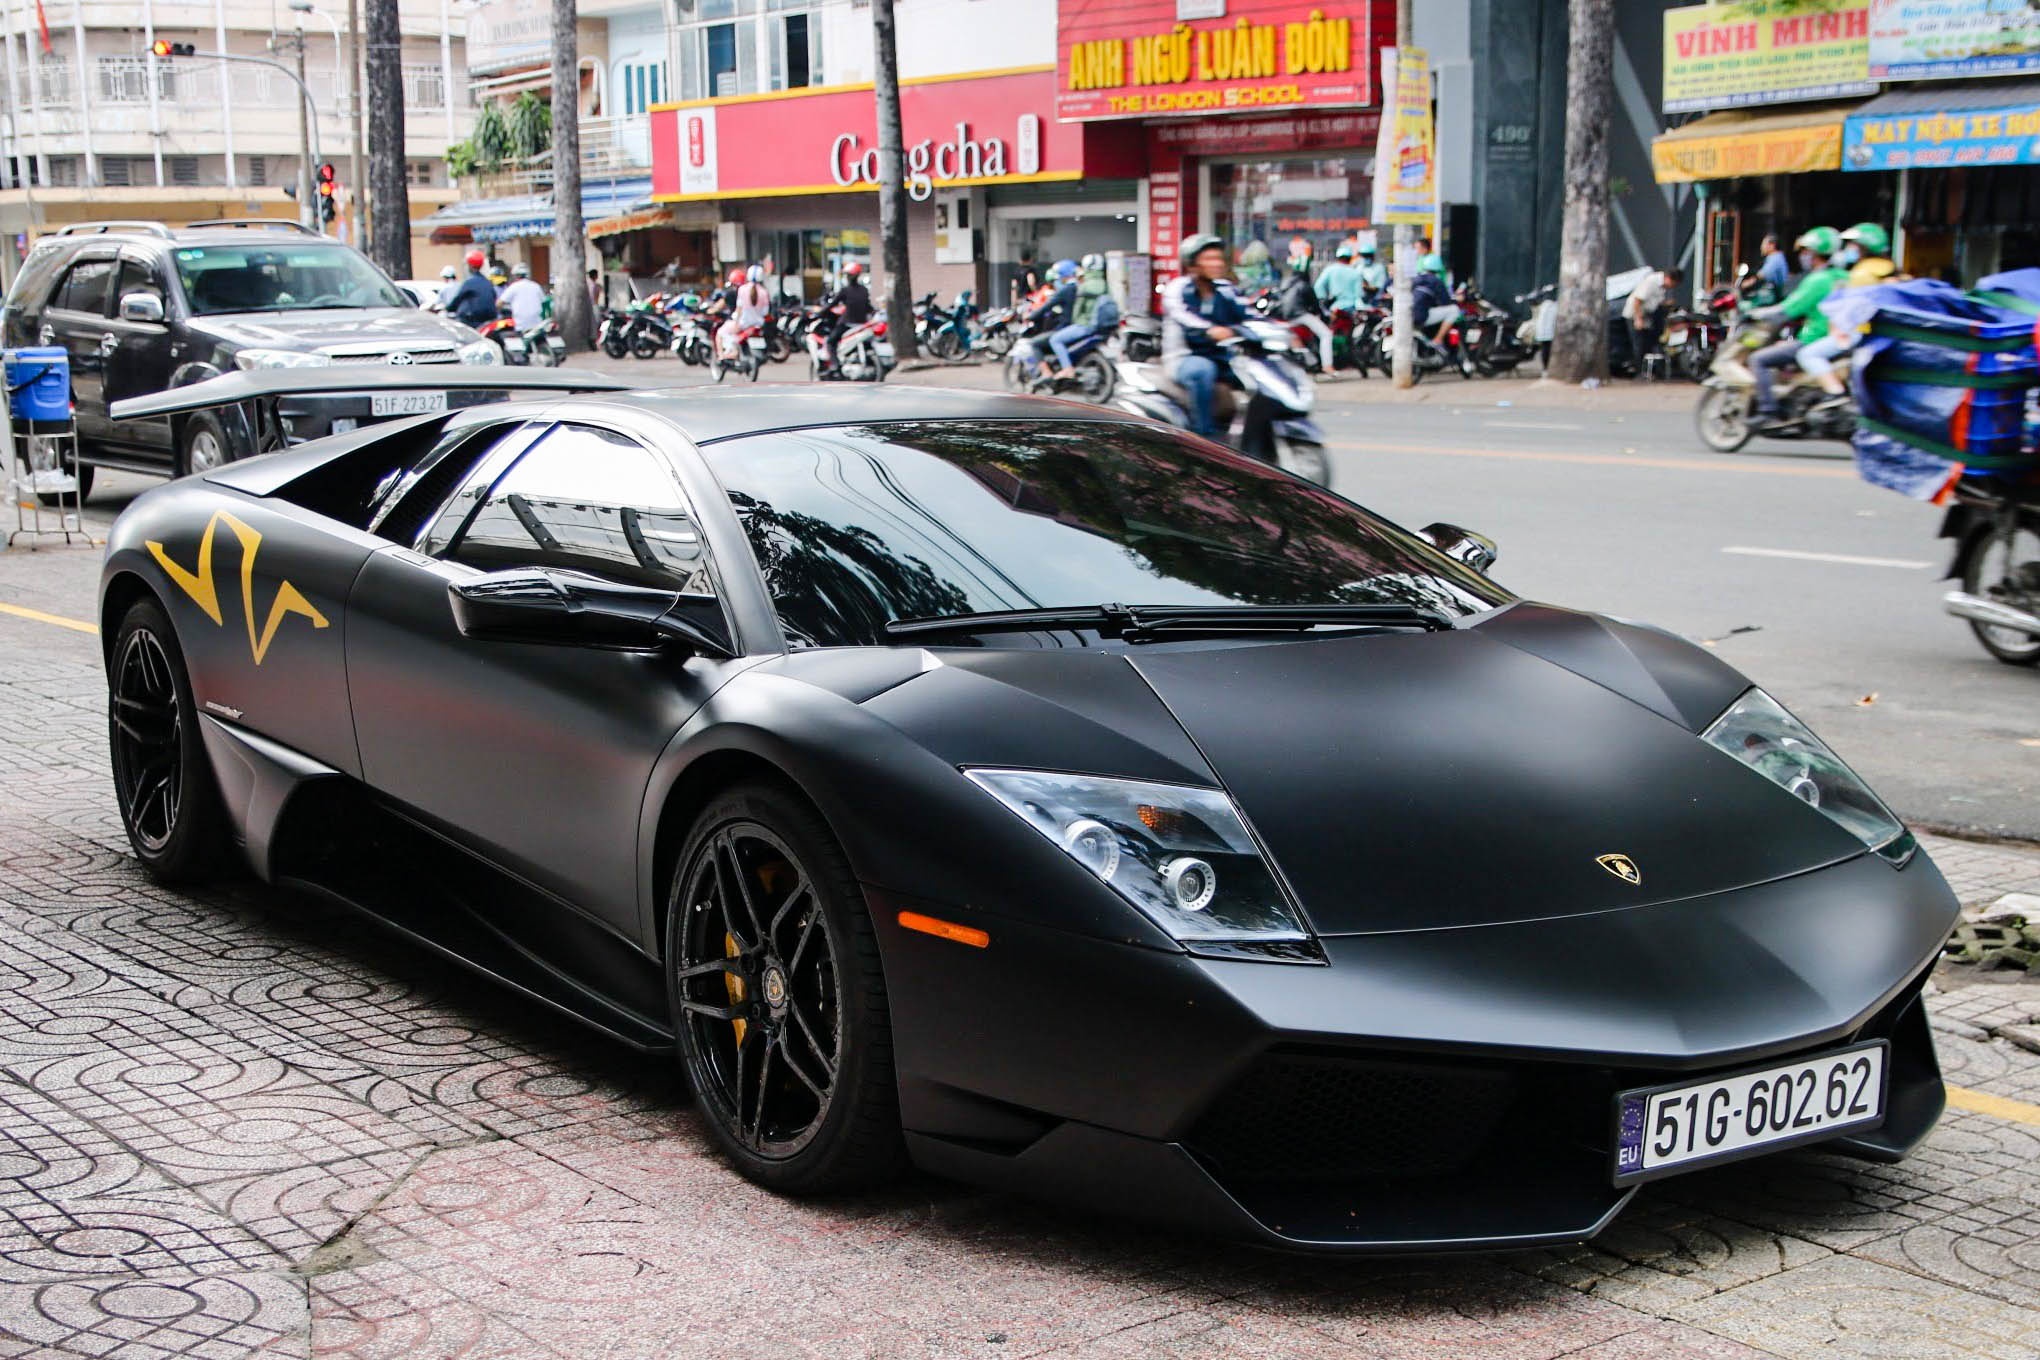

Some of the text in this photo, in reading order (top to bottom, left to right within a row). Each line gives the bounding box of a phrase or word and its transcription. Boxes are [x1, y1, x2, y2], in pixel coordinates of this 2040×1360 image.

[1675, 21, 1758, 59] VĨNH
[1772, 8, 1869, 48] MINH
[1068, 38, 1125, 90] ANH
[1132, 23, 1193, 86] NGỮ
[1198, 17, 1276, 81] LUÂN
[1108, 95, 1143, 113] THE
[1149, 90, 1222, 111] LONDON
[1224, 84, 1305, 106] SCHOOL
[1863, 119, 1912, 145] MAY
[1915, 112, 1967, 145] NỆM
[1971, 116, 2001, 138] XE
[374, 397, 398, 413] 51F
[1654, 1057, 1871, 1157] 51G-602.62
[1619, 1147, 1638, 1166] EU
